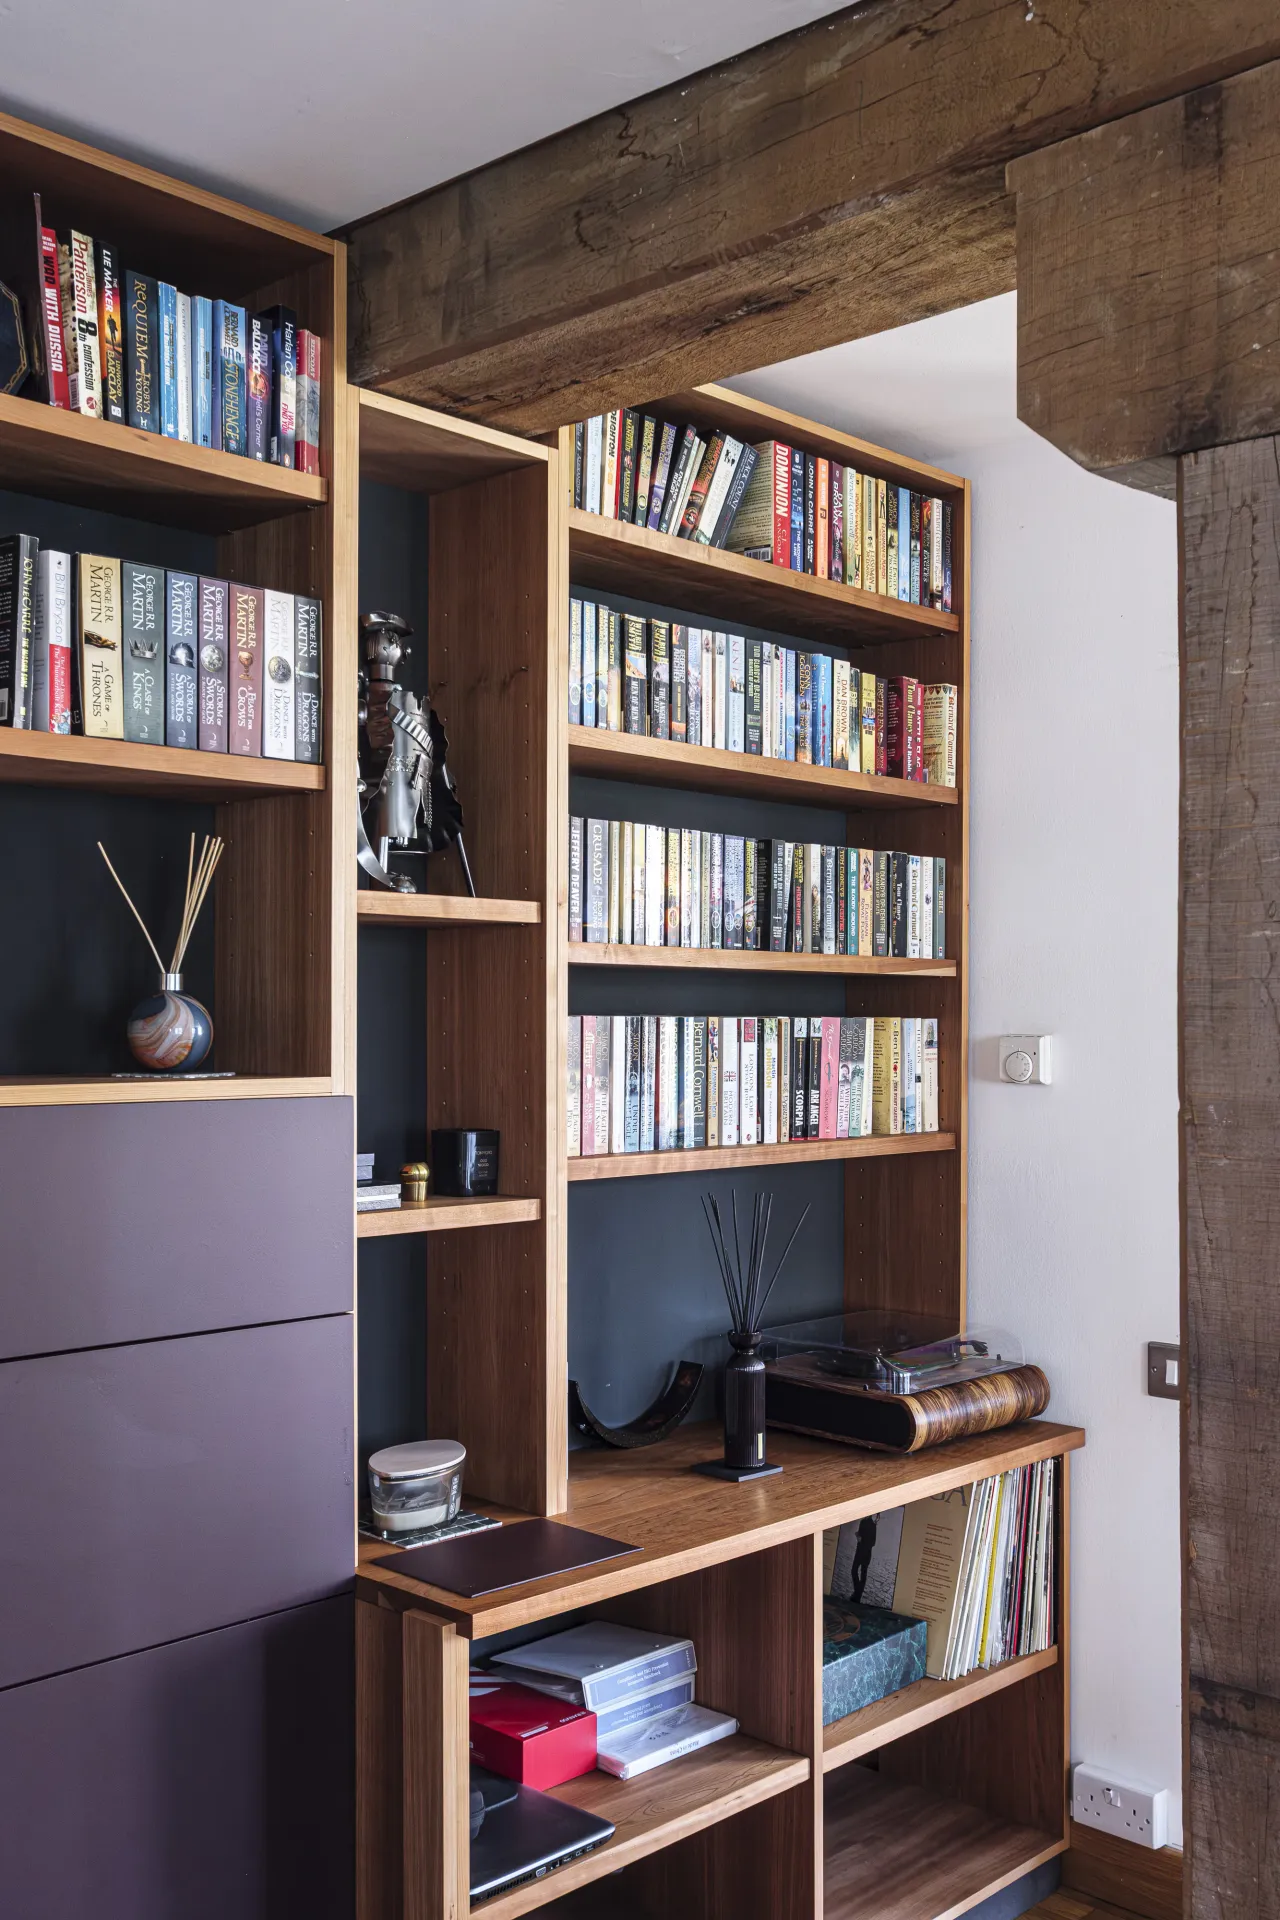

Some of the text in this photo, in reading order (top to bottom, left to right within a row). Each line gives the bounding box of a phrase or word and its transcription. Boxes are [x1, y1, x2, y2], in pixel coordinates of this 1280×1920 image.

[73, 237, 88, 313] Patterson
[102, 250, 113, 312] LIE MAKER
[45, 288, 59, 321] WITH
[48, 324, 63, 372] RUSSIA
[252, 319, 260, 373] BALDACCI
[285, 322, 293, 359] Harlan
[83, 344, 94, 390] confession
[107, 350, 117, 403] BARCLAY
[135, 378, 143, 412] YOUNG
[143, 380, 151, 414] ROBYN
[224, 360, 239, 440] STONEHENGE
[741, 454, 755, 478] BLACK
[776, 445, 788, 517] DOMINION
[731, 481, 746, 511] COUNT
[23, 556, 32, 584] JOHN
[104, 567, 113, 604] GEORGE
[54, 573, 66, 643] Bill Bryson
[90, 564, 103, 622] MARTIN
[133, 572, 145, 630] MARTIN
[146, 575, 155, 611] GEORGE
[171, 579, 184, 636] MARTIN
[184, 582, 193, 619] GEORGE
[215, 588, 224, 622] GEORGE
[203, 584, 215, 641] MARTIN
[236, 592, 248, 648] MARTIN
[248, 596, 256, 630] GEORGE
[298, 603, 309, 657] MARTIN
[92, 661, 103, 716] THRONES
[104, 675, 114, 703] GAME
[132, 672, 143, 709] KINGS
[144, 676, 154, 706] CLASH
[175, 674, 186, 722] SWORDS
[187, 682, 196, 714] STORM
[206, 677, 216, 724] SWORDS
[217, 686, 225, 717] STORM
[238, 687, 248, 726] CROWS
[248, 692, 256, 719] FEAST
[632, 696, 639, 705] OF
[907, 684, 915, 703] Tom
[274, 688, 282, 738] DRAGONS
[302, 692, 311, 741] DRAGONS
[311, 700, 319, 727] DANCE
[906, 705, 916, 734] Clancy
[947, 697, 956, 769] Bernard Cornwell
[571, 827, 579, 912] JEFFERY DEAVER
[693, 1021, 705, 1118] Bernard Cornwell
[795, 1090, 804, 1126] SCORPIA
[810, 1090, 819, 1125] ARK ANGEL
